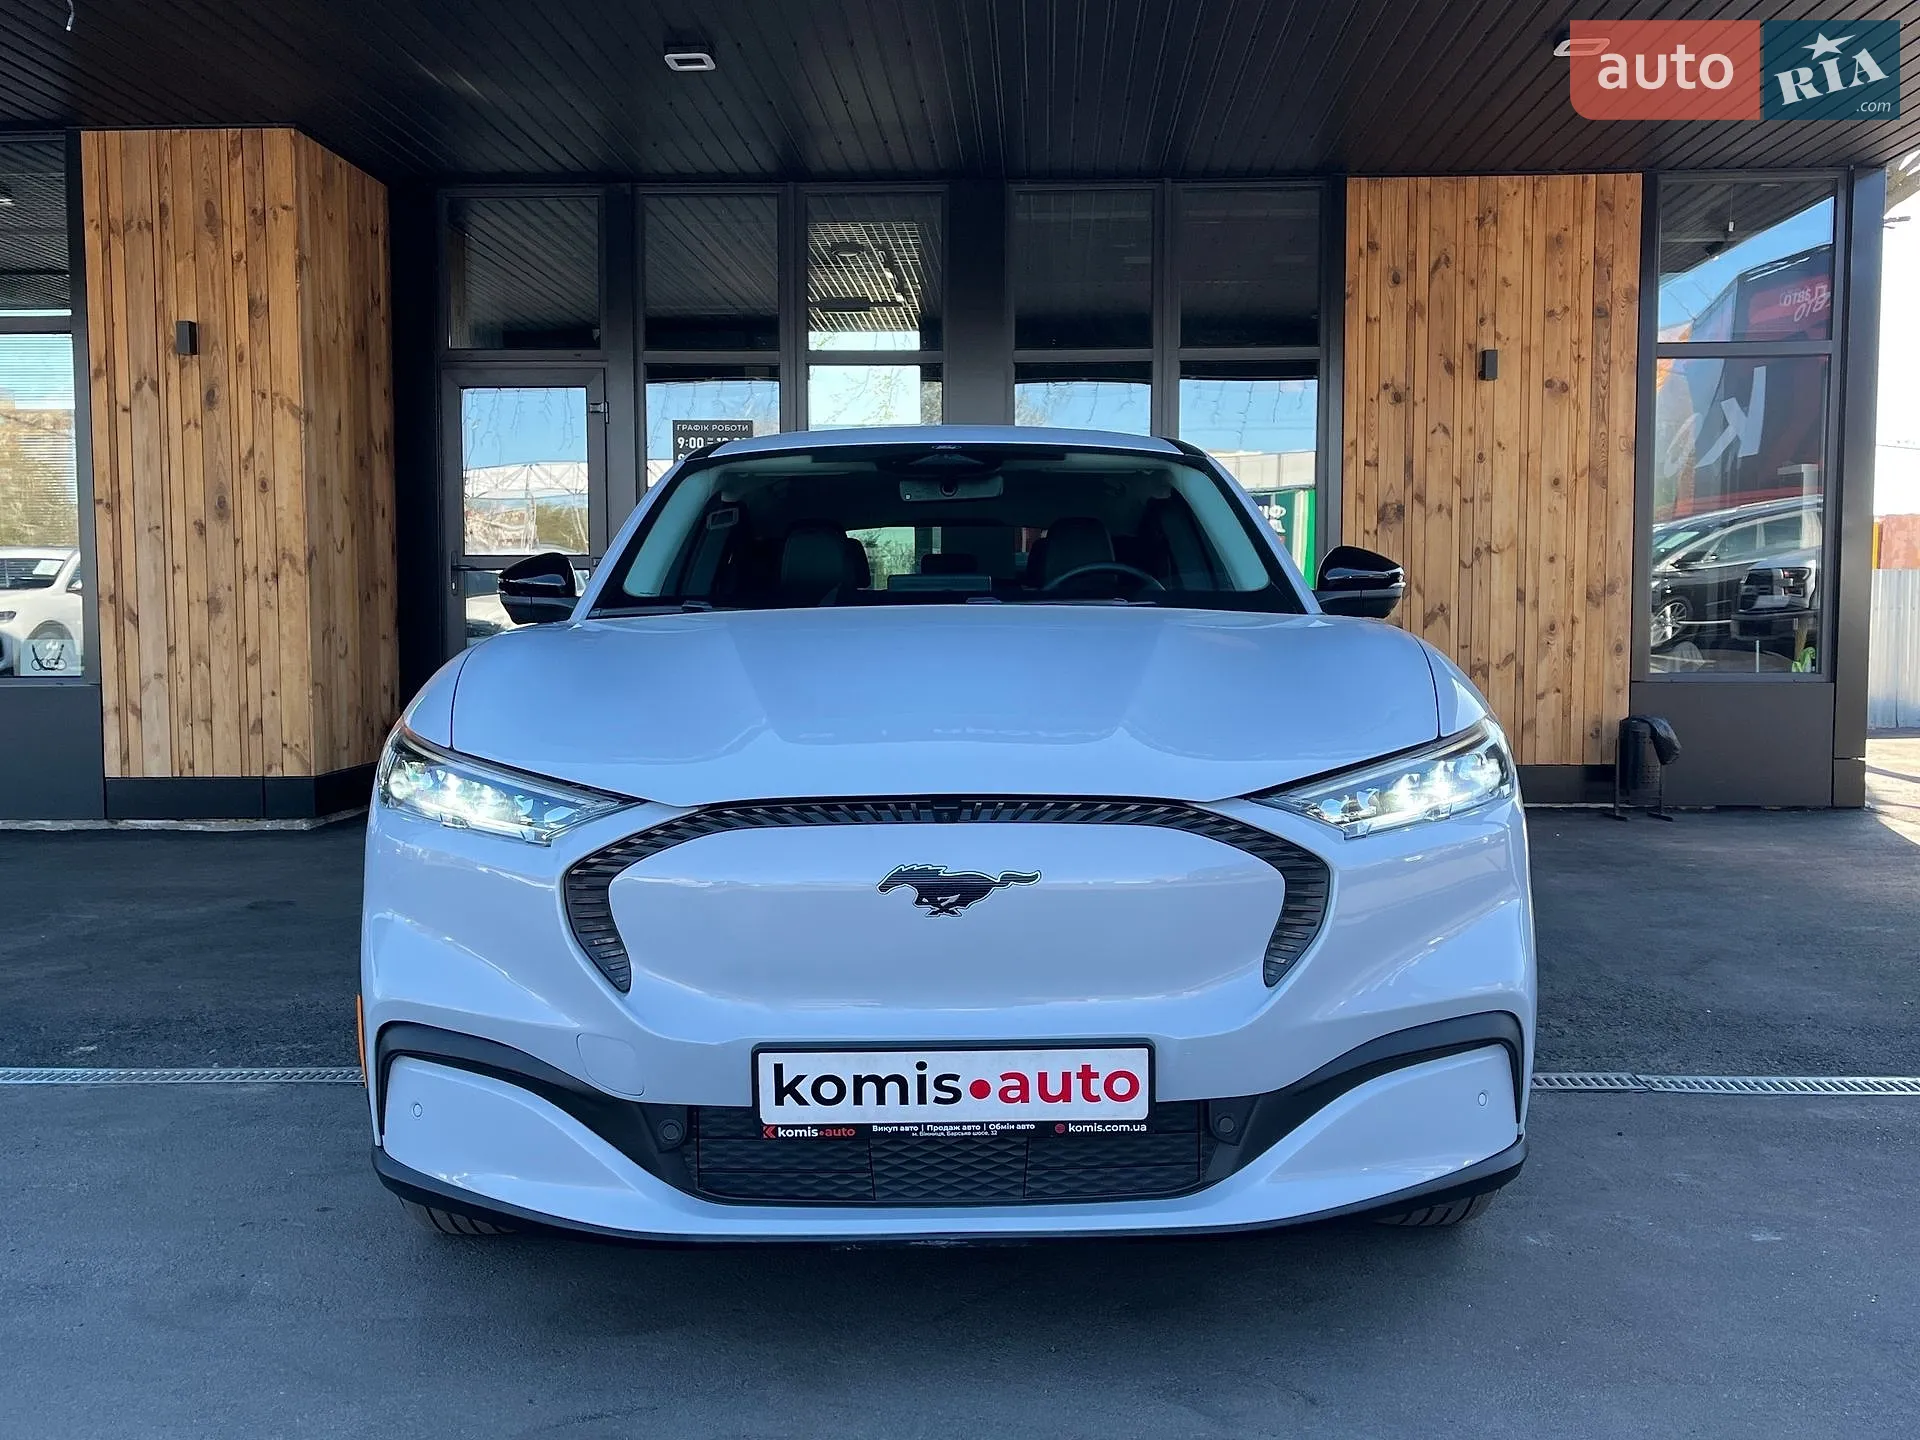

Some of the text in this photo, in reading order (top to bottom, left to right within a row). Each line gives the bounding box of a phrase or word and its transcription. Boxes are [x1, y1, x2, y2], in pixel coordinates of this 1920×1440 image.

[676, 424, 749, 432] ГРАФІК РОБОТИ
[677, 436, 705, 449] 9:00
[872, 1124, 899, 1133] Викуп
[926, 1123, 961, 1132] Продаж
[988, 1122, 1015, 1130] Обмін
[1068, 1122, 1147, 1133] komis.com.ua
